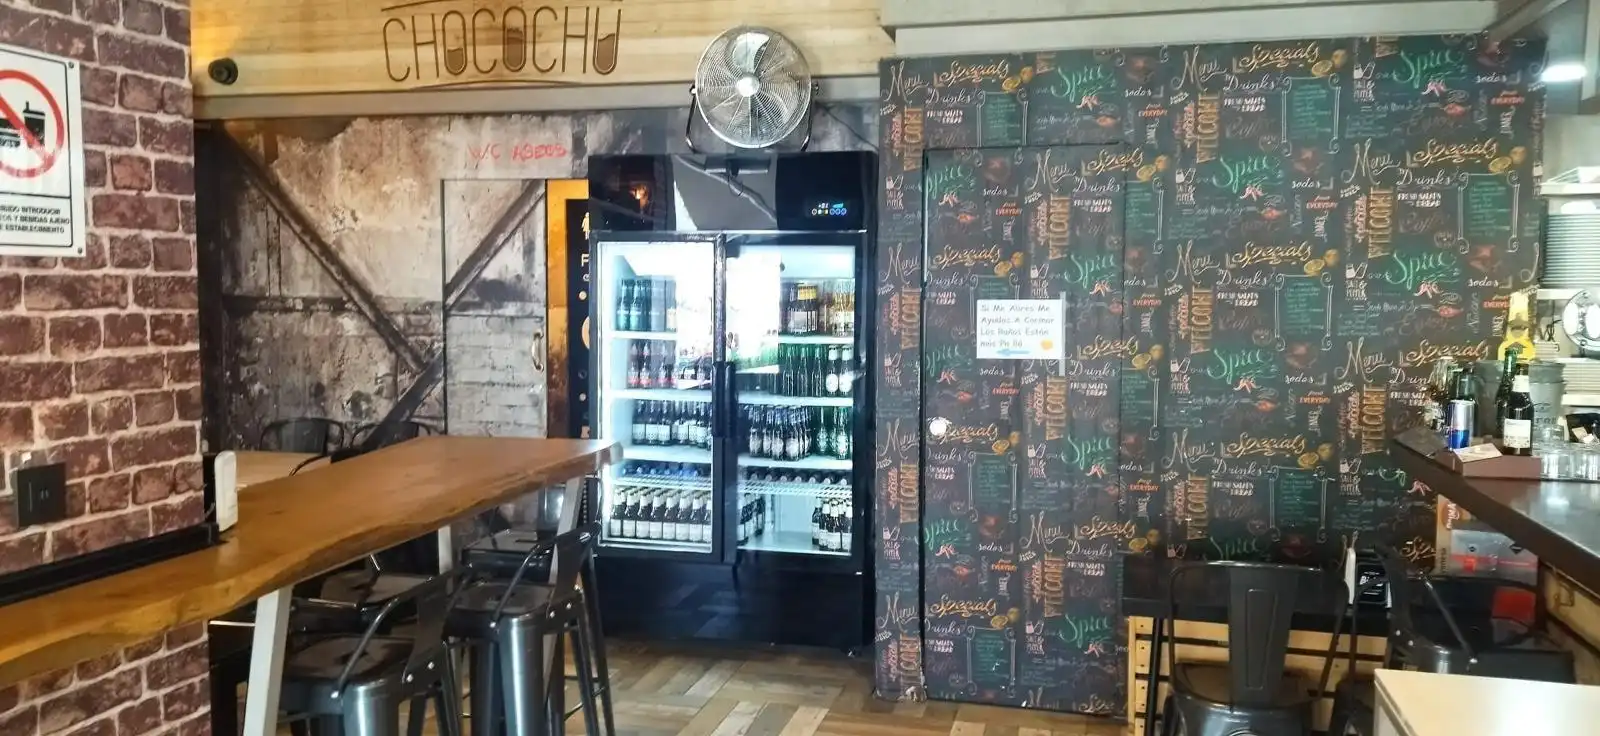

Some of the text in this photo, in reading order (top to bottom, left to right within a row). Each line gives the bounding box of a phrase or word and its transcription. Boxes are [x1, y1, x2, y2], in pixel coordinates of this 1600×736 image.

[383, 5, 622, 82] CHOCOCHU
[1239, 40, 1320, 72] Specials
[940, 59, 1010, 86] Specials
[1171, 44, 1228, 91] Menu
[1475, 72, 1507, 84] sodas
[882, 60, 929, 104] Menu
[1124, 85, 1152, 98] sodas
[1223, 73, 1276, 92] Drinks
[925, 88, 972, 106] Drinks
[1341, 137, 1401, 186] Menu
[1413, 137, 1498, 167] Specials
[1026, 148, 1077, 193] Menu
[1292, 175, 1322, 189] sodas
[1396, 168, 1451, 186] Drinks
[983, 185, 1008, 197] sodas
[934, 242, 1002, 270] Specials
[1164, 238, 1220, 285] Menu
[1232, 239, 1313, 269] Specials
[1216, 267, 1268, 286] Drinks
[1468, 274, 1499, 287] sodas
[1334, 336, 1394, 382] Menu
[1406, 338, 1491, 367] Specials
[980, 366, 1004, 377] sodas
[1285, 372, 1314, 384] sodas
[1161, 427, 1216, 473] Menu
[1227, 431, 1307, 458] Specials
[1212, 457, 1263, 476] Drinks
[978, 542, 1003, 552] sodas
[932, 592, 998, 618] Specials
